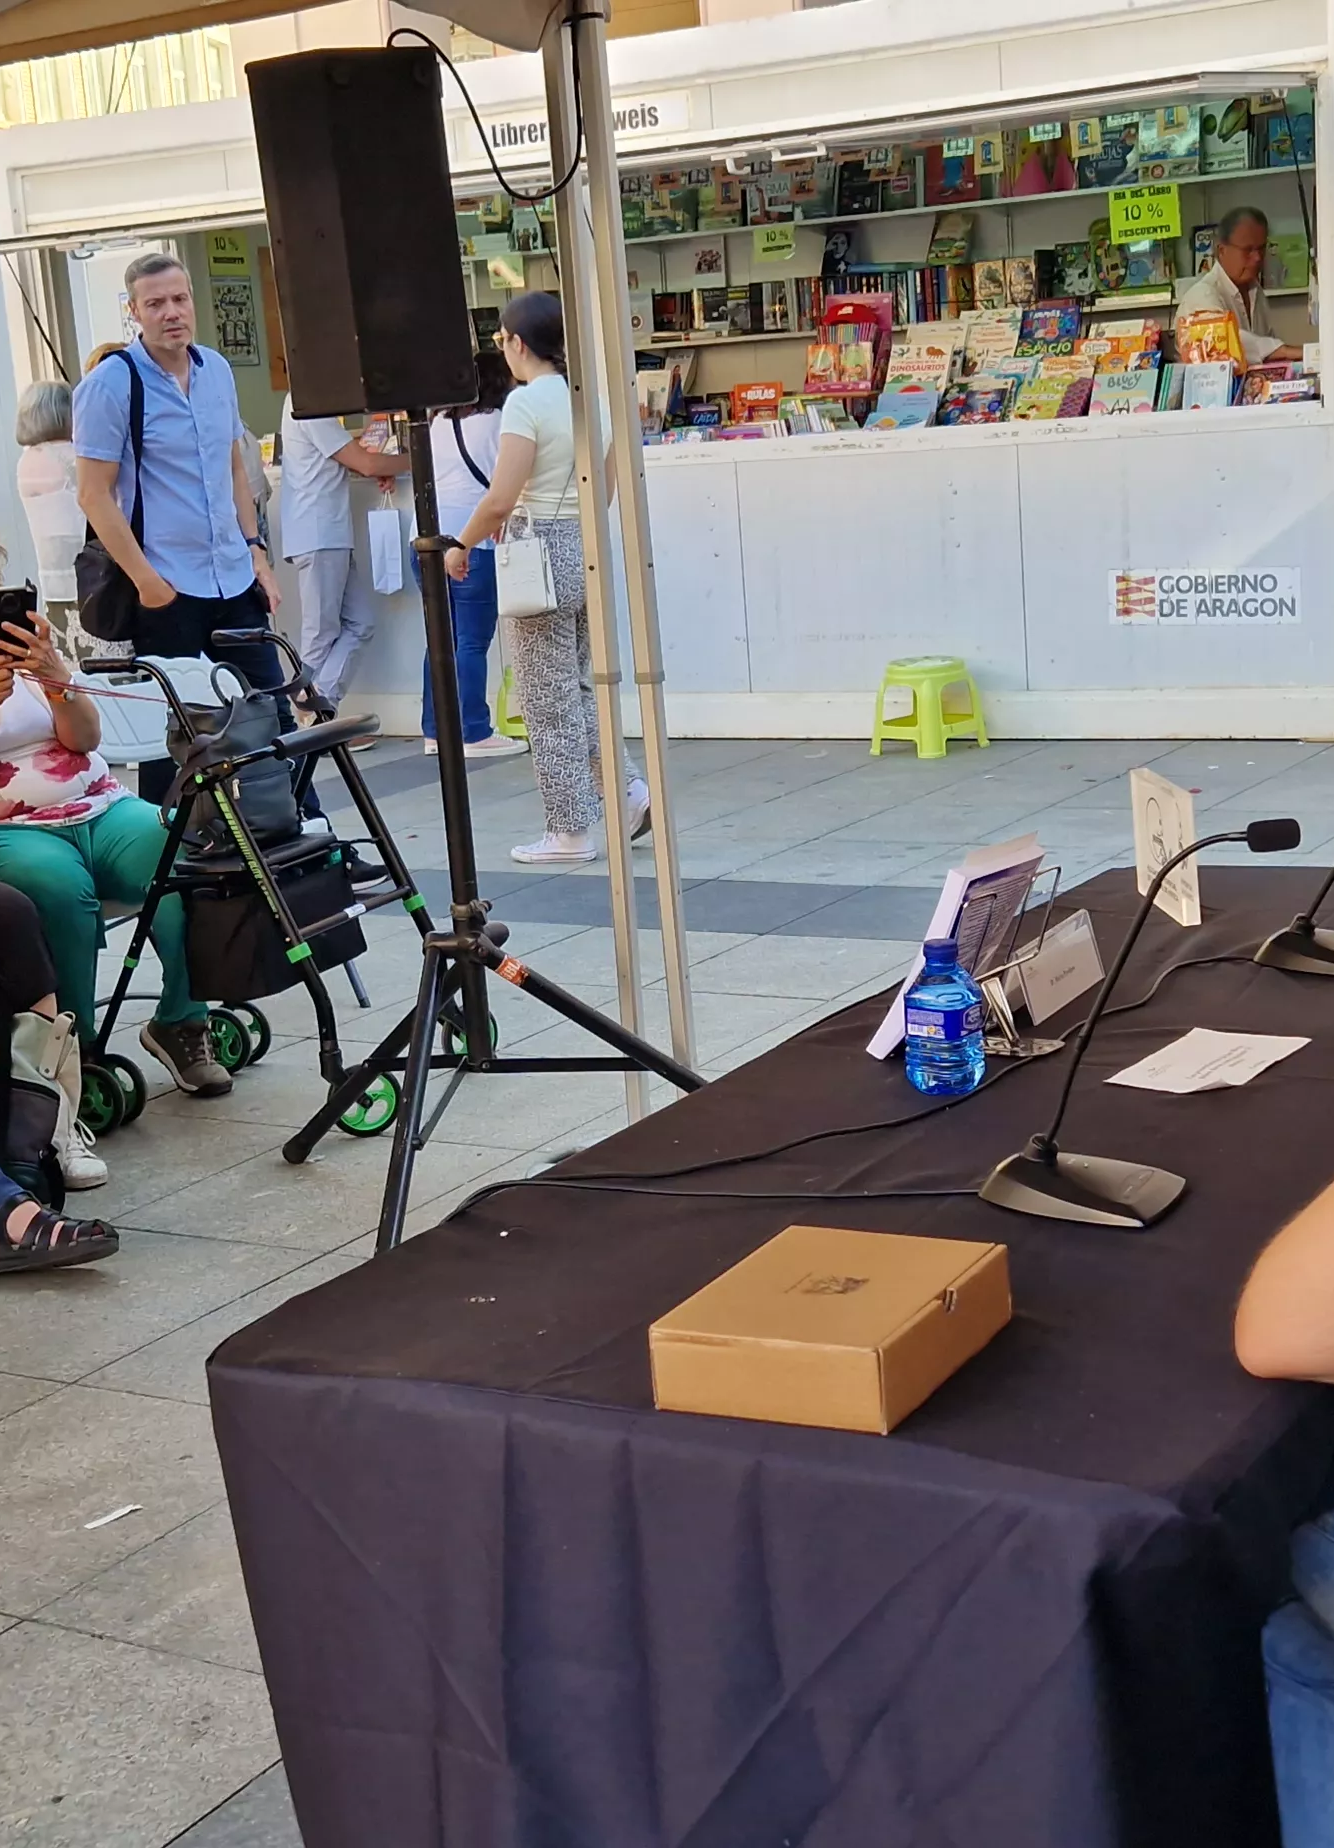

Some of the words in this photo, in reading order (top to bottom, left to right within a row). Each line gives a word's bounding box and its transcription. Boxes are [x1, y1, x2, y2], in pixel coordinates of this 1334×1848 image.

[491, 122, 549, 148] Librer
[613, 103, 659, 130] weis
[1130, 189, 1145, 198] DEL
[1148, 186, 1171, 196] LIBRO
[1123, 204, 1142, 221] 10
[1147, 203, 1164, 218] %
[766, 230, 777, 242] 10
[1118, 224, 1171, 239] DESCUENTO
[215, 237, 226, 251] 10
[1016, 341, 1072, 356] ESPACIO
[1158, 574, 1278, 594] GOBIERNO
[1159, 599, 1188, 617] DE
[1196, 597, 1296, 618] ARAGON
